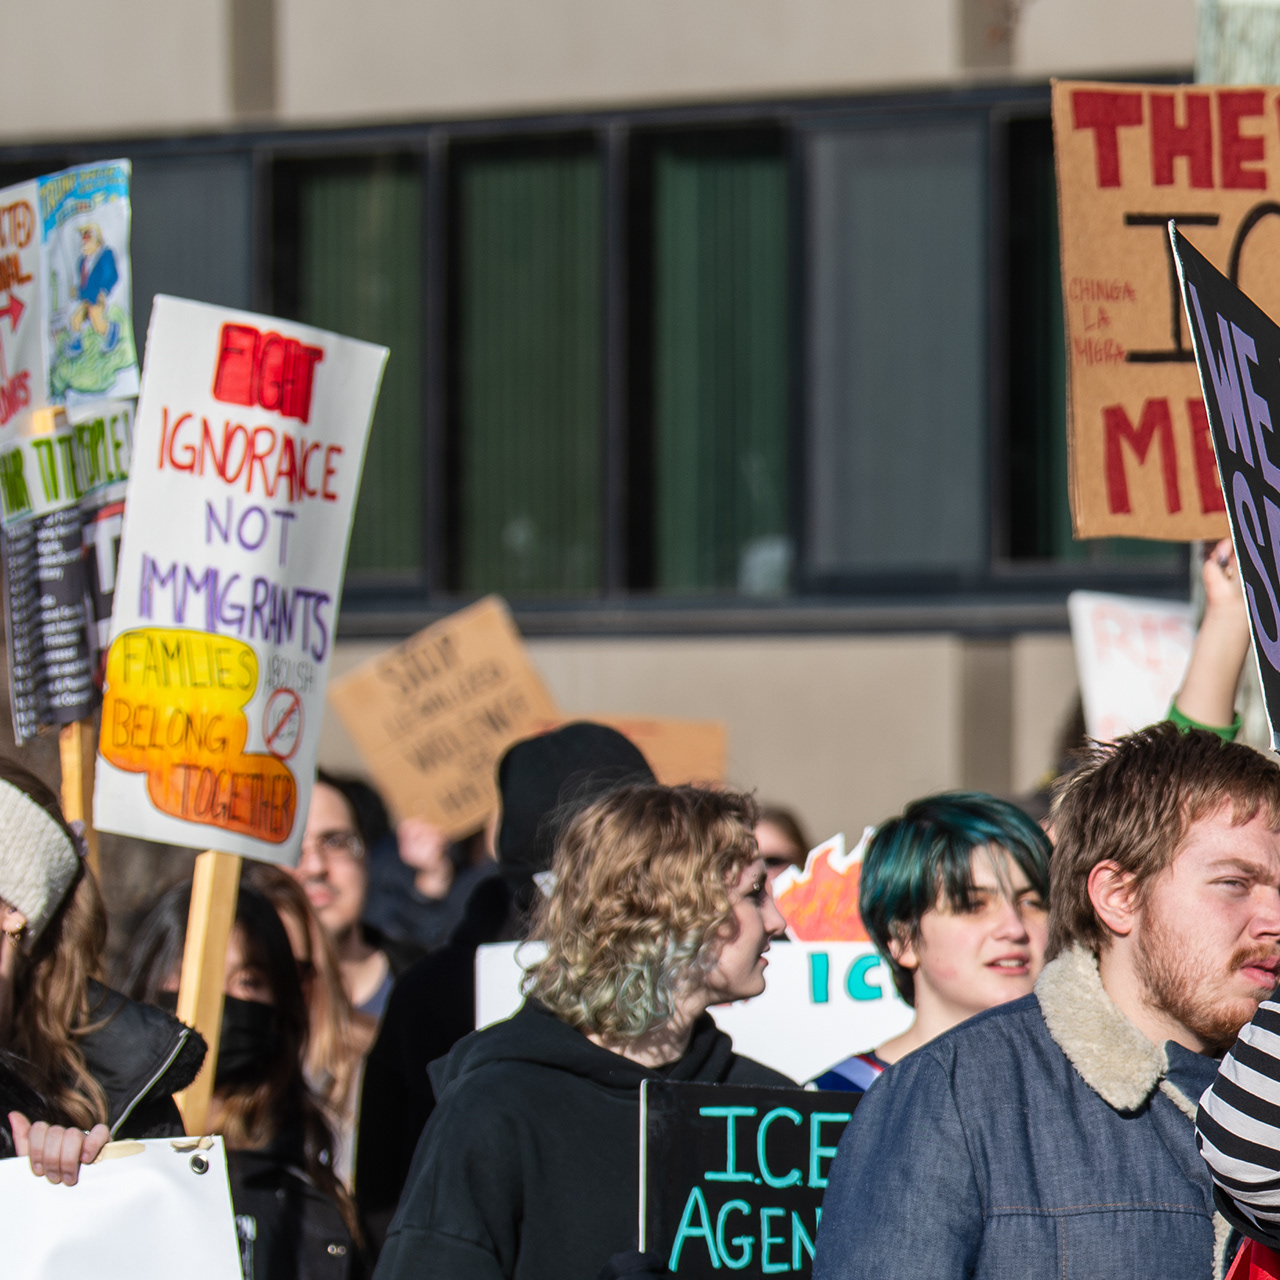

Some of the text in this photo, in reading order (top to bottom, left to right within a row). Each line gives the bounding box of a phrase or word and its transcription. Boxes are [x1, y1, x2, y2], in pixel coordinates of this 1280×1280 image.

[1070, 89, 1268, 191] THE
[1069, 277, 1137, 303] CHINGA
[1082, 304, 1111, 333] LA
[205, 496, 296, 568] NOT
[112, 698, 229, 754] BELONG
[172, 763, 292, 834] TOGETHER
